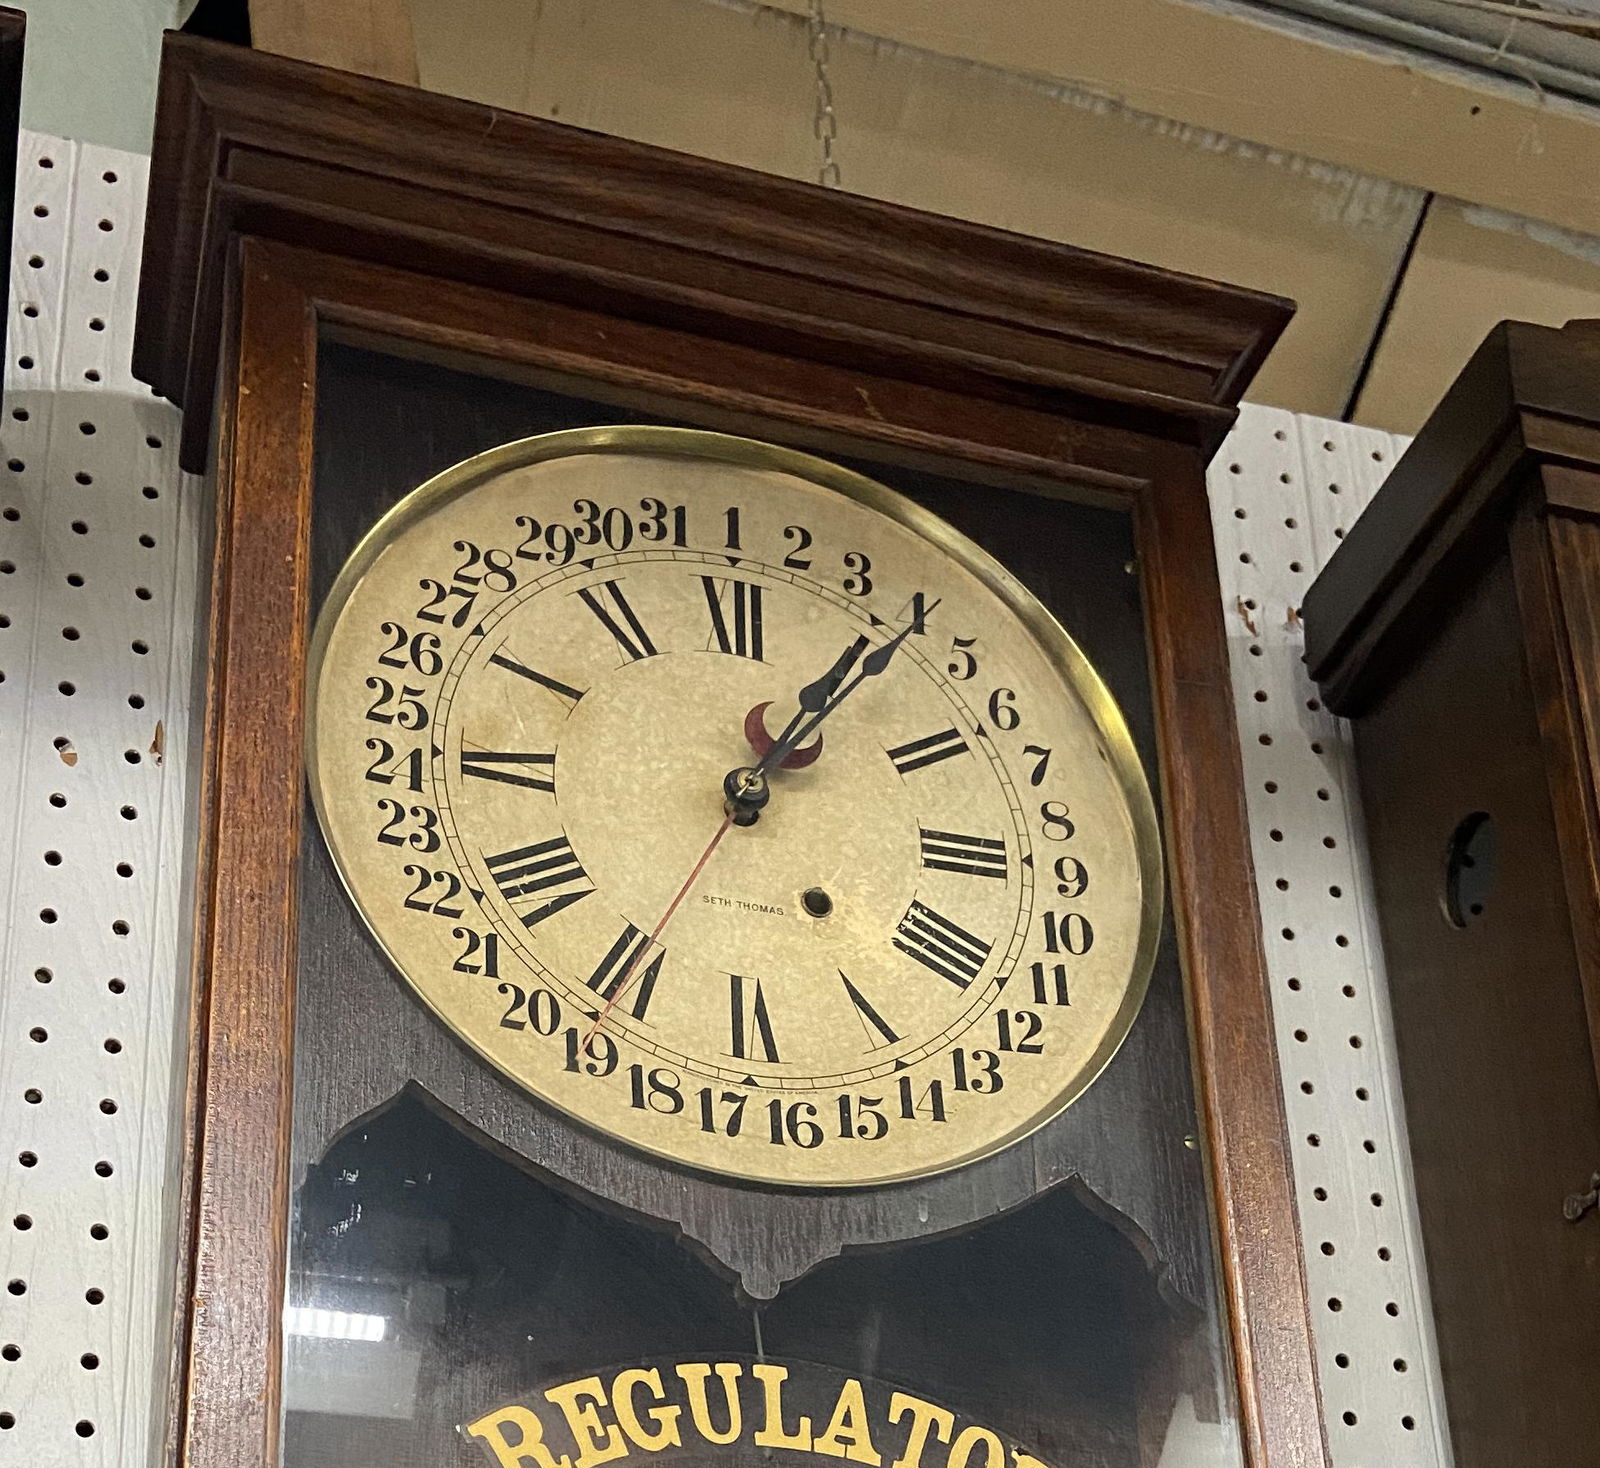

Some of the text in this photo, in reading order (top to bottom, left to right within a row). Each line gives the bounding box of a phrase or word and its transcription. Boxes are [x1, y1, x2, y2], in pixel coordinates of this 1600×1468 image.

[515, 515, 576, 566] 29
[573, 499, 633, 551] 30
[639, 498, 688, 547] 31
[723, 507, 741, 550] 1
[783, 525, 813, 570] 2
[452, 540, 517, 593] 28
[843, 551, 873, 596] 3
[416, 578, 479, 629] 27
[565, 577, 672, 671] XI
[688, 573, 775, 667] XII
[895, 591, 932, 636] 4
[378, 622, 444, 676] 26
[948, 636, 978, 681] 5
[365, 676, 429, 731] 25
[483, 636, 592, 721] X
[988, 687, 1021, 731] 6
[365, 737, 429, 793] 24
[461, 727, 559, 805] IX
[879, 717, 976, 786] II
[1022, 744, 1052, 787] 7
[377, 798, 441, 853] 23
[1040, 801, 1075, 841] 8
[916, 816, 1008, 889] III
[1054, 856, 1089, 898] 9
[403, 864, 465, 919] 22
[478, 824, 598, 939] VIII
[702, 895, 784, 916] SETH THOMAS
[452, 926, 500, 979] 21
[891, 889, 997, 998] IIII
[1041, 911, 1094, 955] 10
[576, 913, 667, 1029] VII
[1028, 962, 1071, 1006] 11
[498, 982, 560, 1036] 20
[718, 971, 792, 1064] VI
[838, 967, 911, 1055] V
[994, 1009, 1045, 1054] 12
[561, 1026, 618, 1077] 19
[950, 1047, 1003, 1094] 13
[625, 1063, 684, 1114] 18
[695, 1087, 748, 1137] 17
[896, 1075, 954, 1122] 14
[766, 1098, 824, 1148] 16
[835, 1094, 889, 1140] 15
